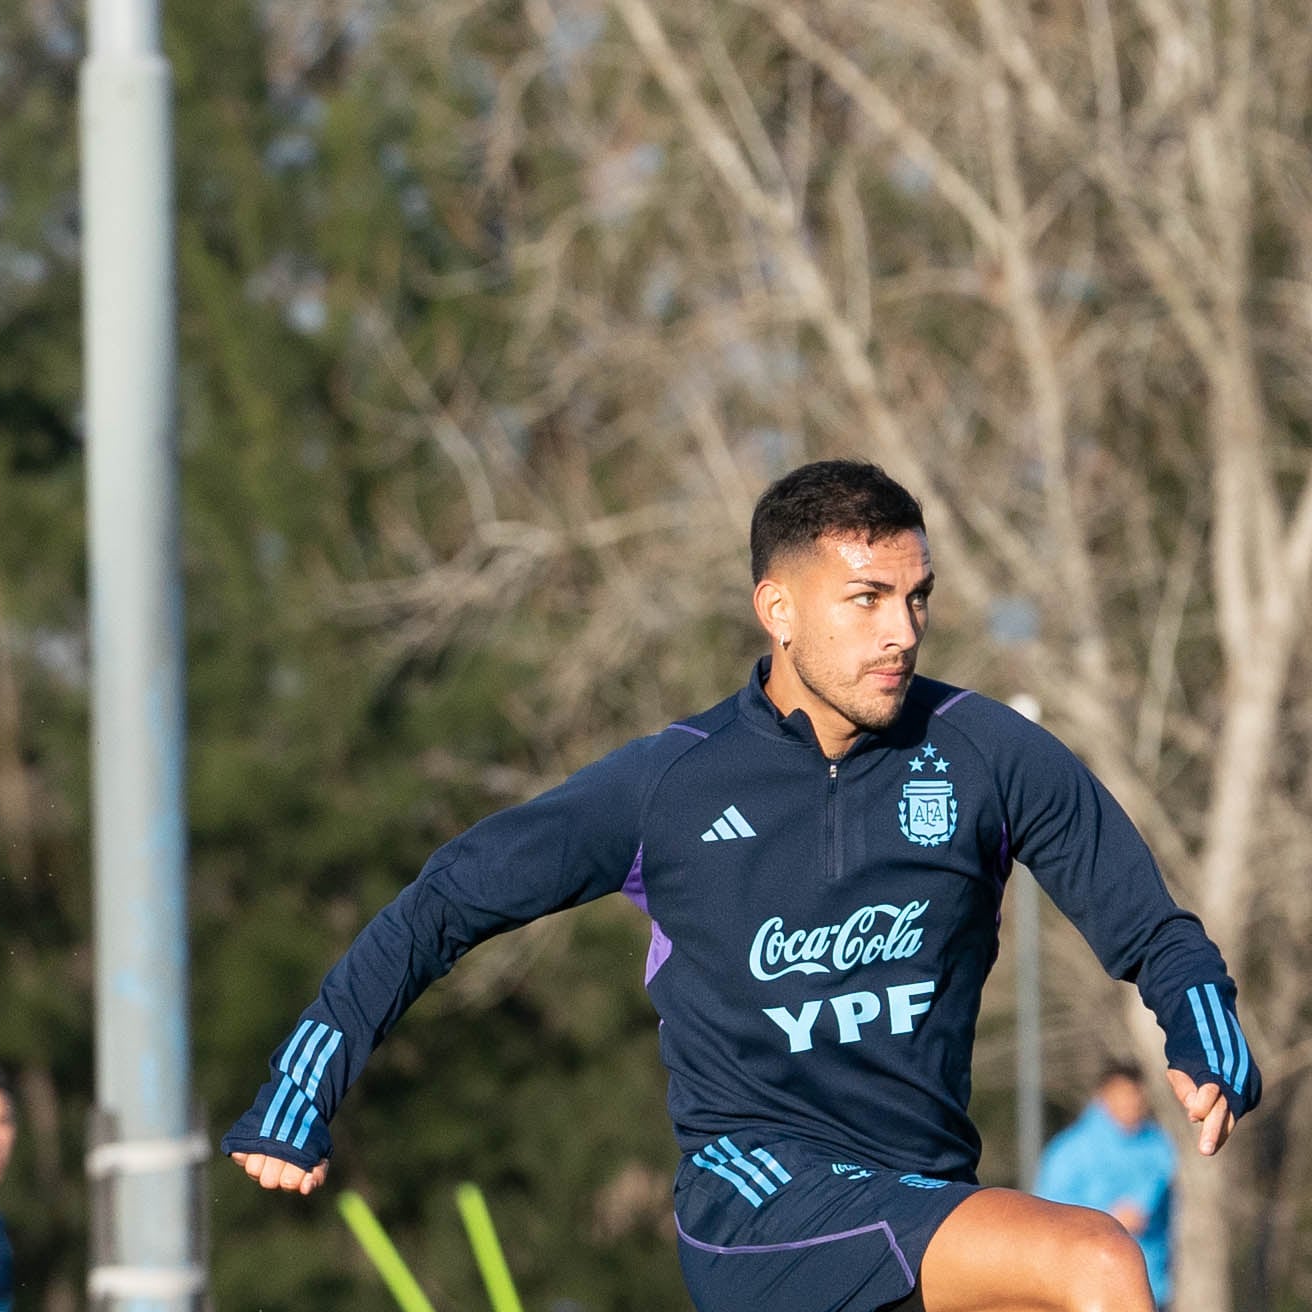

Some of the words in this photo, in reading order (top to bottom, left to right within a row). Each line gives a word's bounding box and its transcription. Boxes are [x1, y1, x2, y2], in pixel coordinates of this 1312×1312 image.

[913, 798, 944, 828] AFA
[749, 899, 930, 981] Coca-Cola
[762, 980, 935, 1053] YPF
